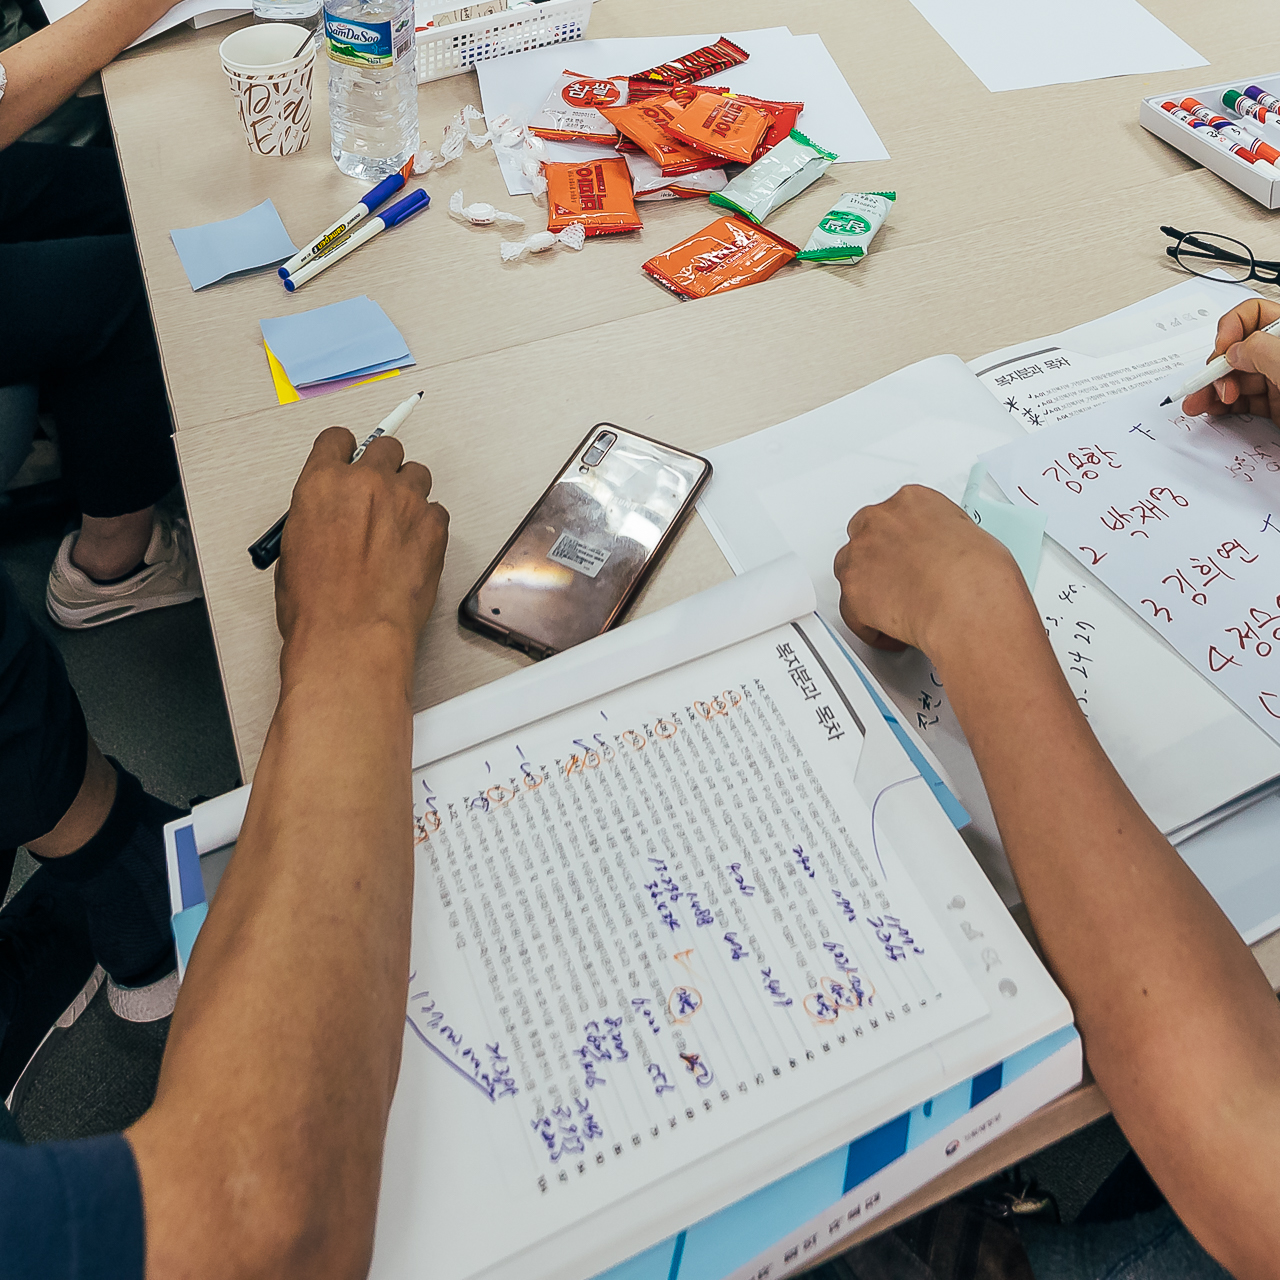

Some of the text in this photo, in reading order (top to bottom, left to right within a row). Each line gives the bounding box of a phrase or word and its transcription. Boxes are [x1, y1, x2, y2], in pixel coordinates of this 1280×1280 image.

[327, 21, 380, 44] SamDaSoo
[314, 221, 346, 250] namepen
[994, 355, 1071, 388] 복지분과 목차
[1042, 442, 1123, 495] 김용한
[1079, 544, 1108, 567] 2
[1140, 536, 1260, 624] 3 김희연
[1206, 643, 1245, 675] 4
[774, 642, 846, 742] 복지분과 목차
